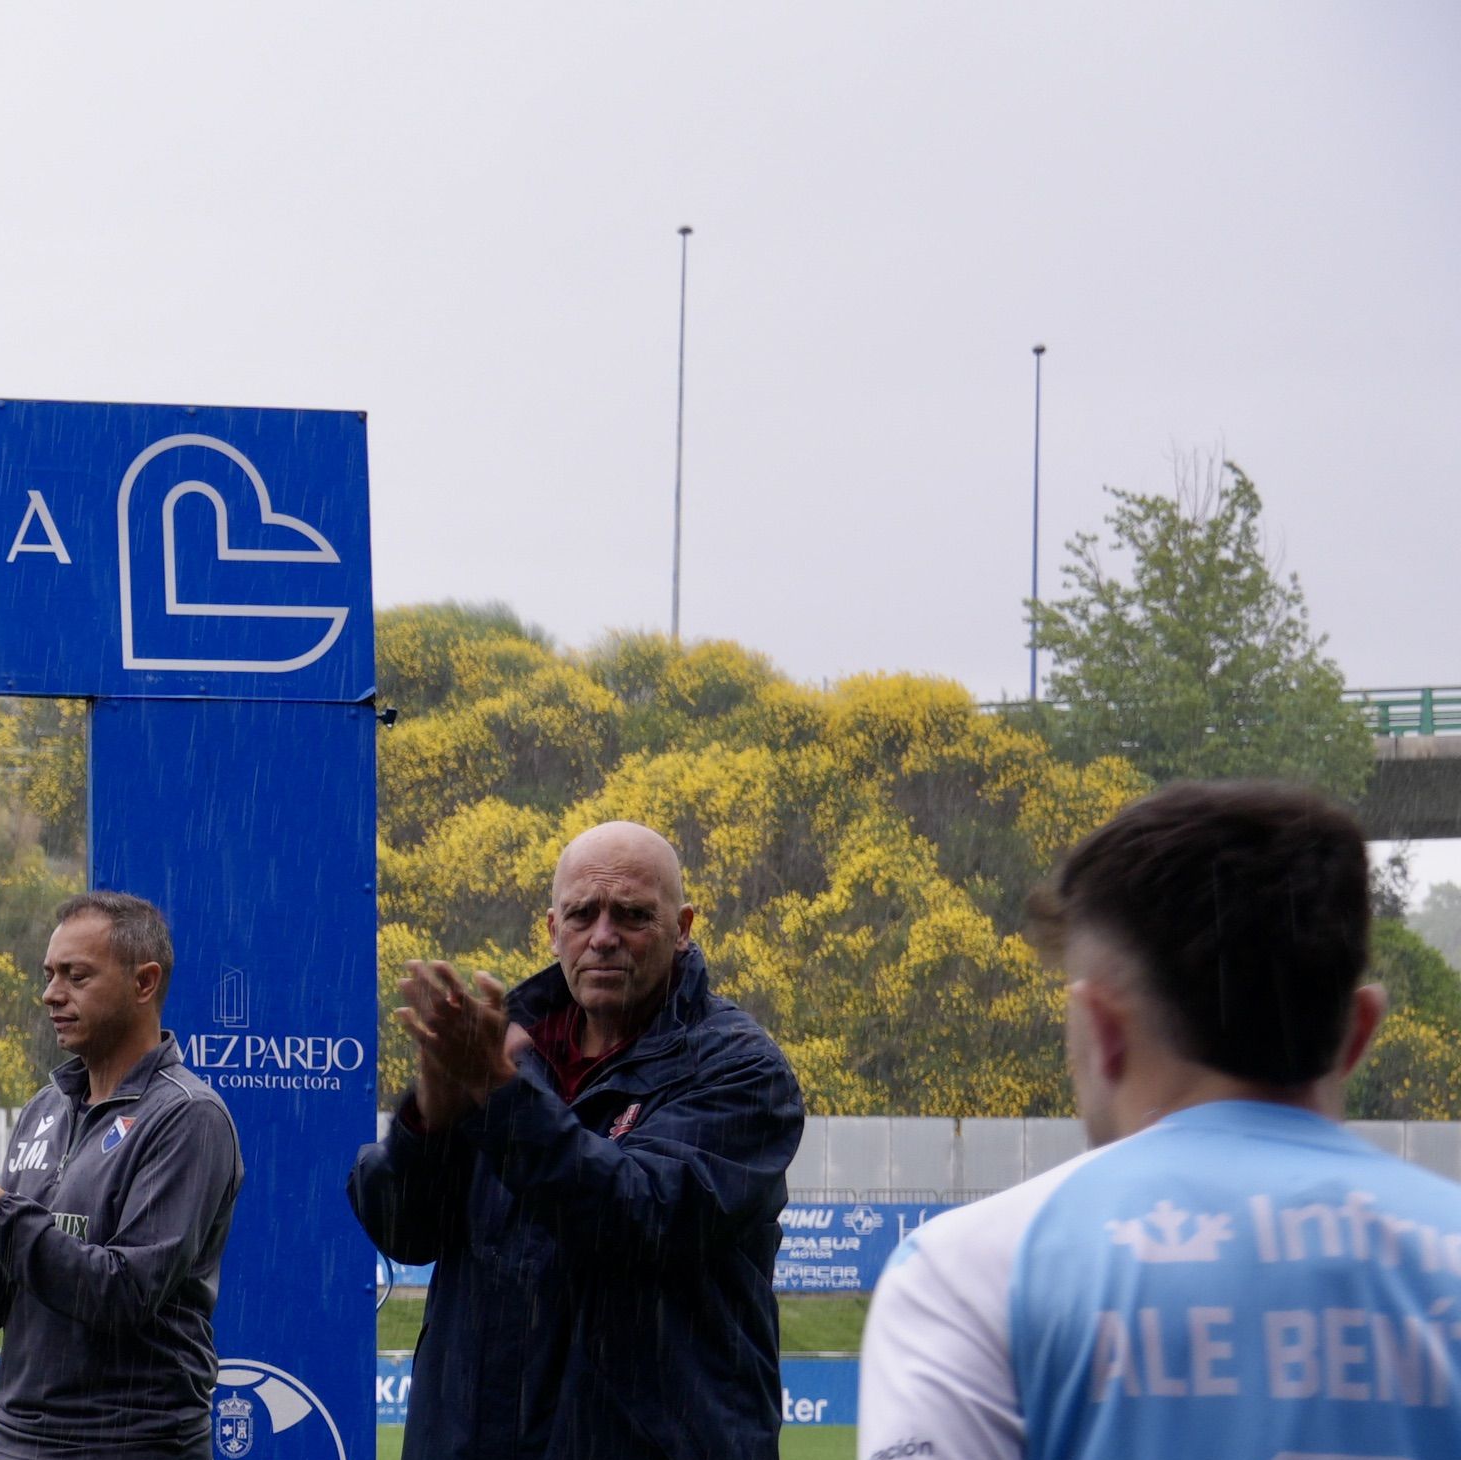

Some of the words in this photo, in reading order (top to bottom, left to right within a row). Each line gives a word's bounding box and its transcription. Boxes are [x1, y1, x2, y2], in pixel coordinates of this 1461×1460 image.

[175, 1034, 240, 1069] MEZ
[244, 1035, 365, 1076] PAREJO
[218, 1072, 341, 1091] constructora
[8, 1139, 50, 1173] J.M.
[1089, 1305, 1239, 1404] ALE
[1263, 1296, 1461, 1408] BENÍ
